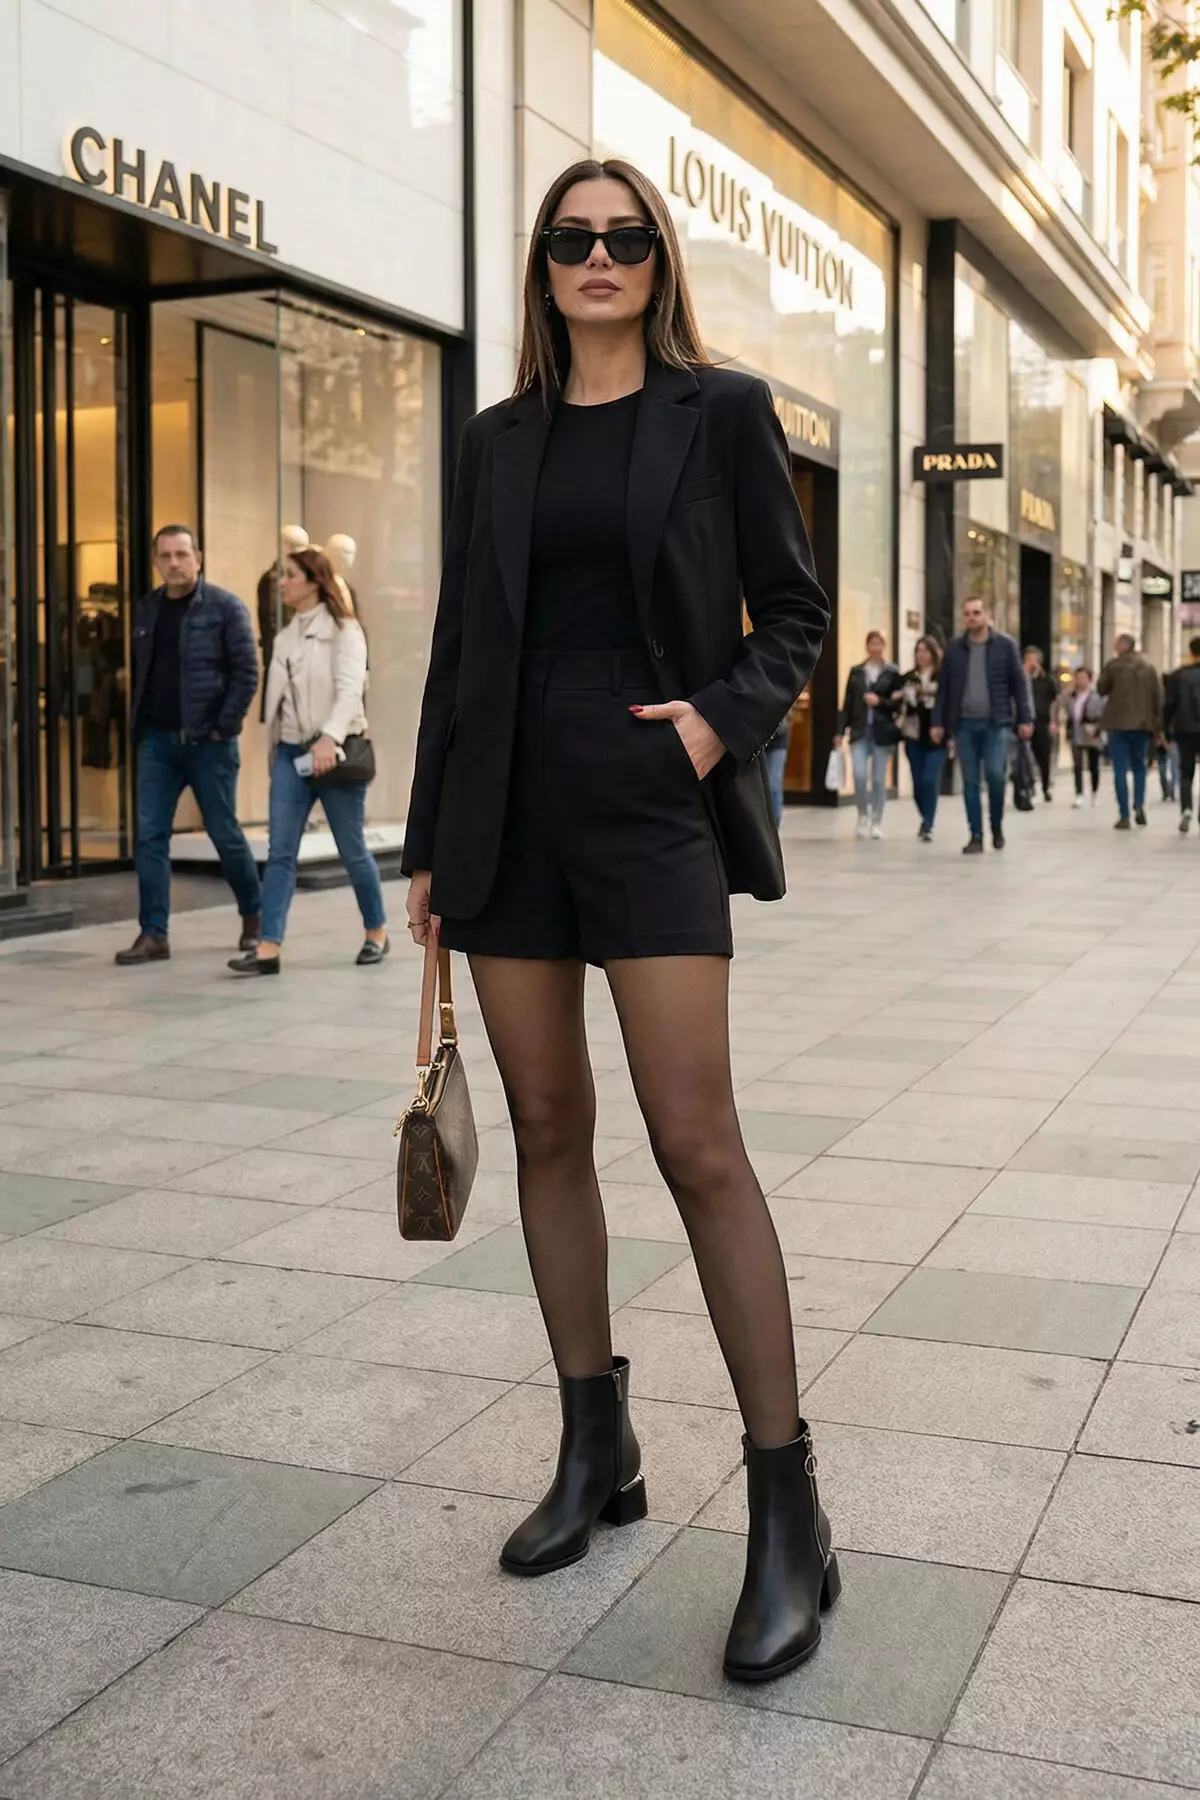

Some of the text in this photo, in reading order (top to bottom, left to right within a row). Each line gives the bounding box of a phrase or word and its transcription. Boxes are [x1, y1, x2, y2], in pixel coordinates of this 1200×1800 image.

[70, 126, 278, 254] CHANEL
[669, 135, 853, 311] LOUIS VUITTON
[923, 452, 998, 471] PRADA
